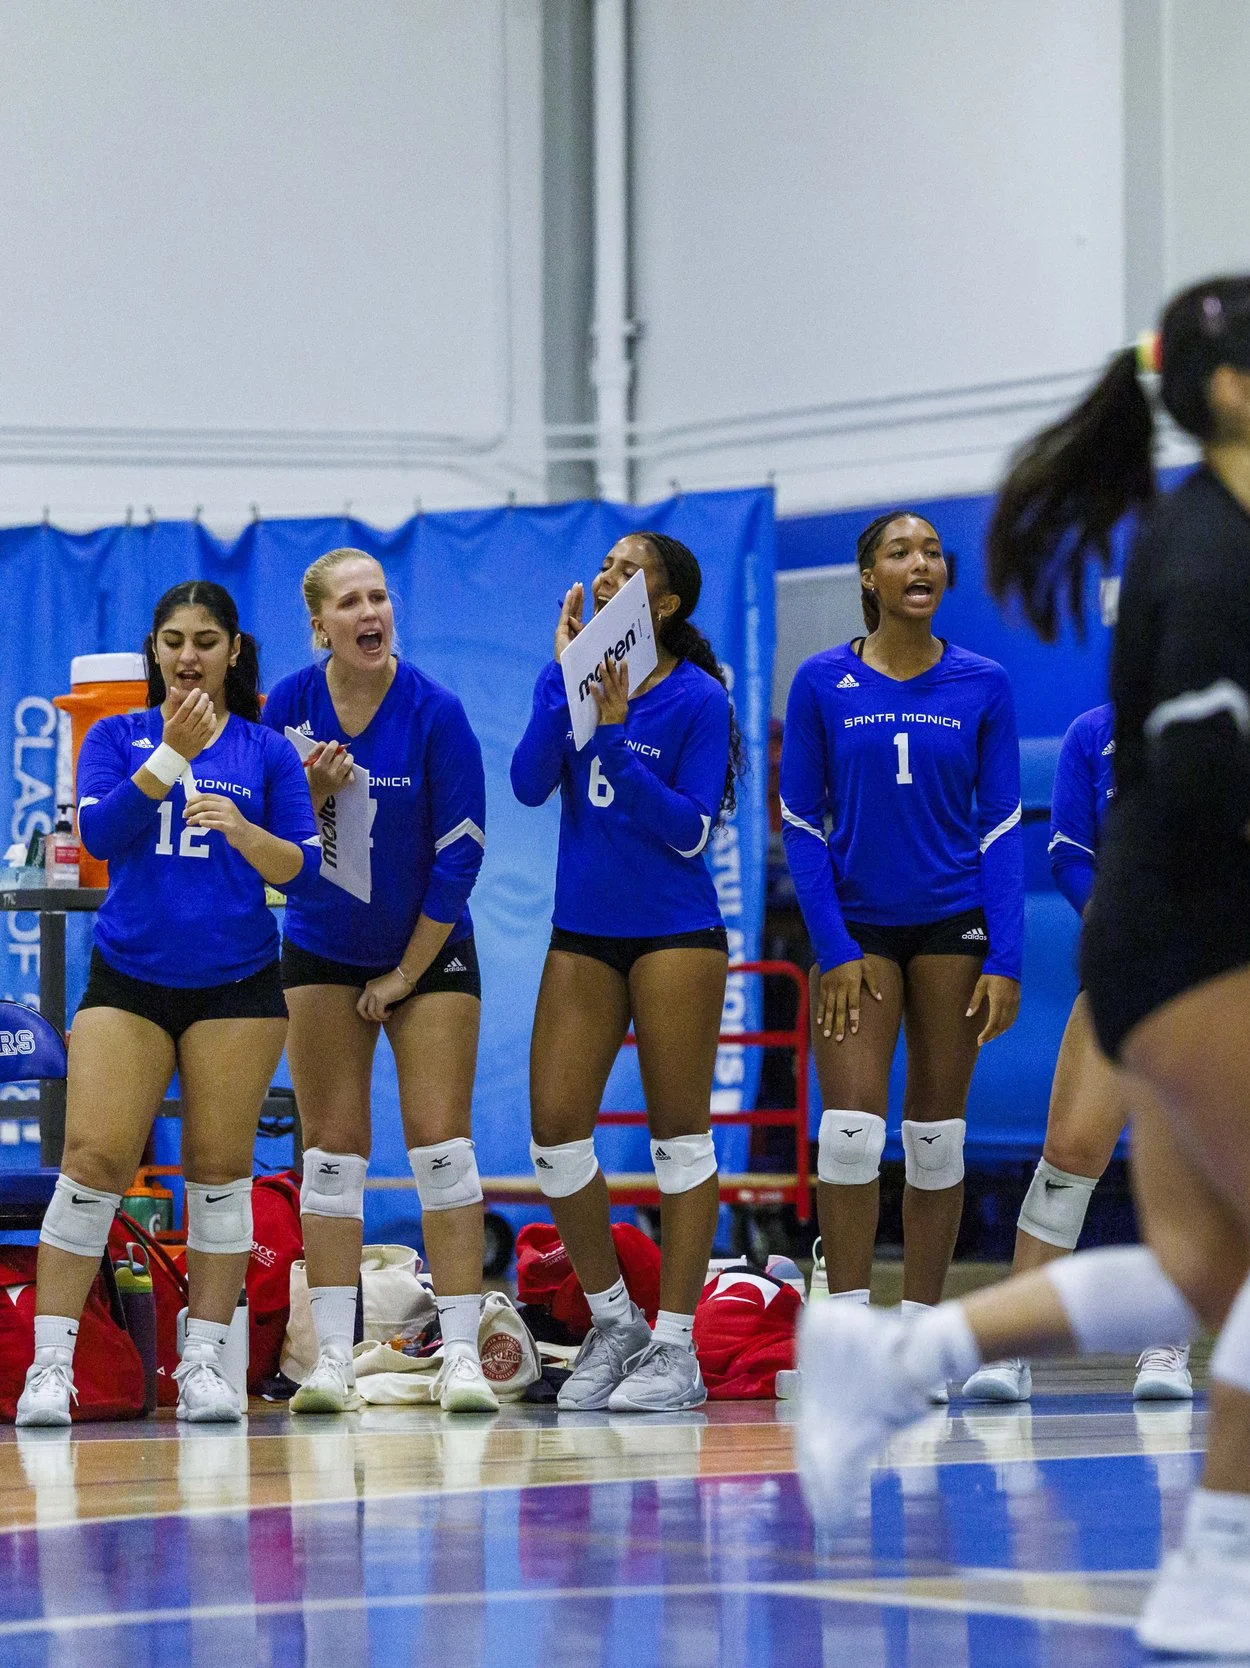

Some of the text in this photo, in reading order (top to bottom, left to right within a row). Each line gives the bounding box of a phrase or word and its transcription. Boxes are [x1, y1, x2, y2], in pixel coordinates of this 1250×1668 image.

[844, 713, 961, 730] SANTA MONICA
[624, 739, 661, 759] NICA
[893, 732, 913, 785] 1
[11, 696, 57, 845] CLAS
[368, 776, 411, 787] ONICA
[588, 755, 615, 808] 6
[155, 801, 211, 859] 12
[443, 965, 467, 973] adidas
[0, 1029, 36, 1057] RS
[251, 1240, 277, 1260] BCC
